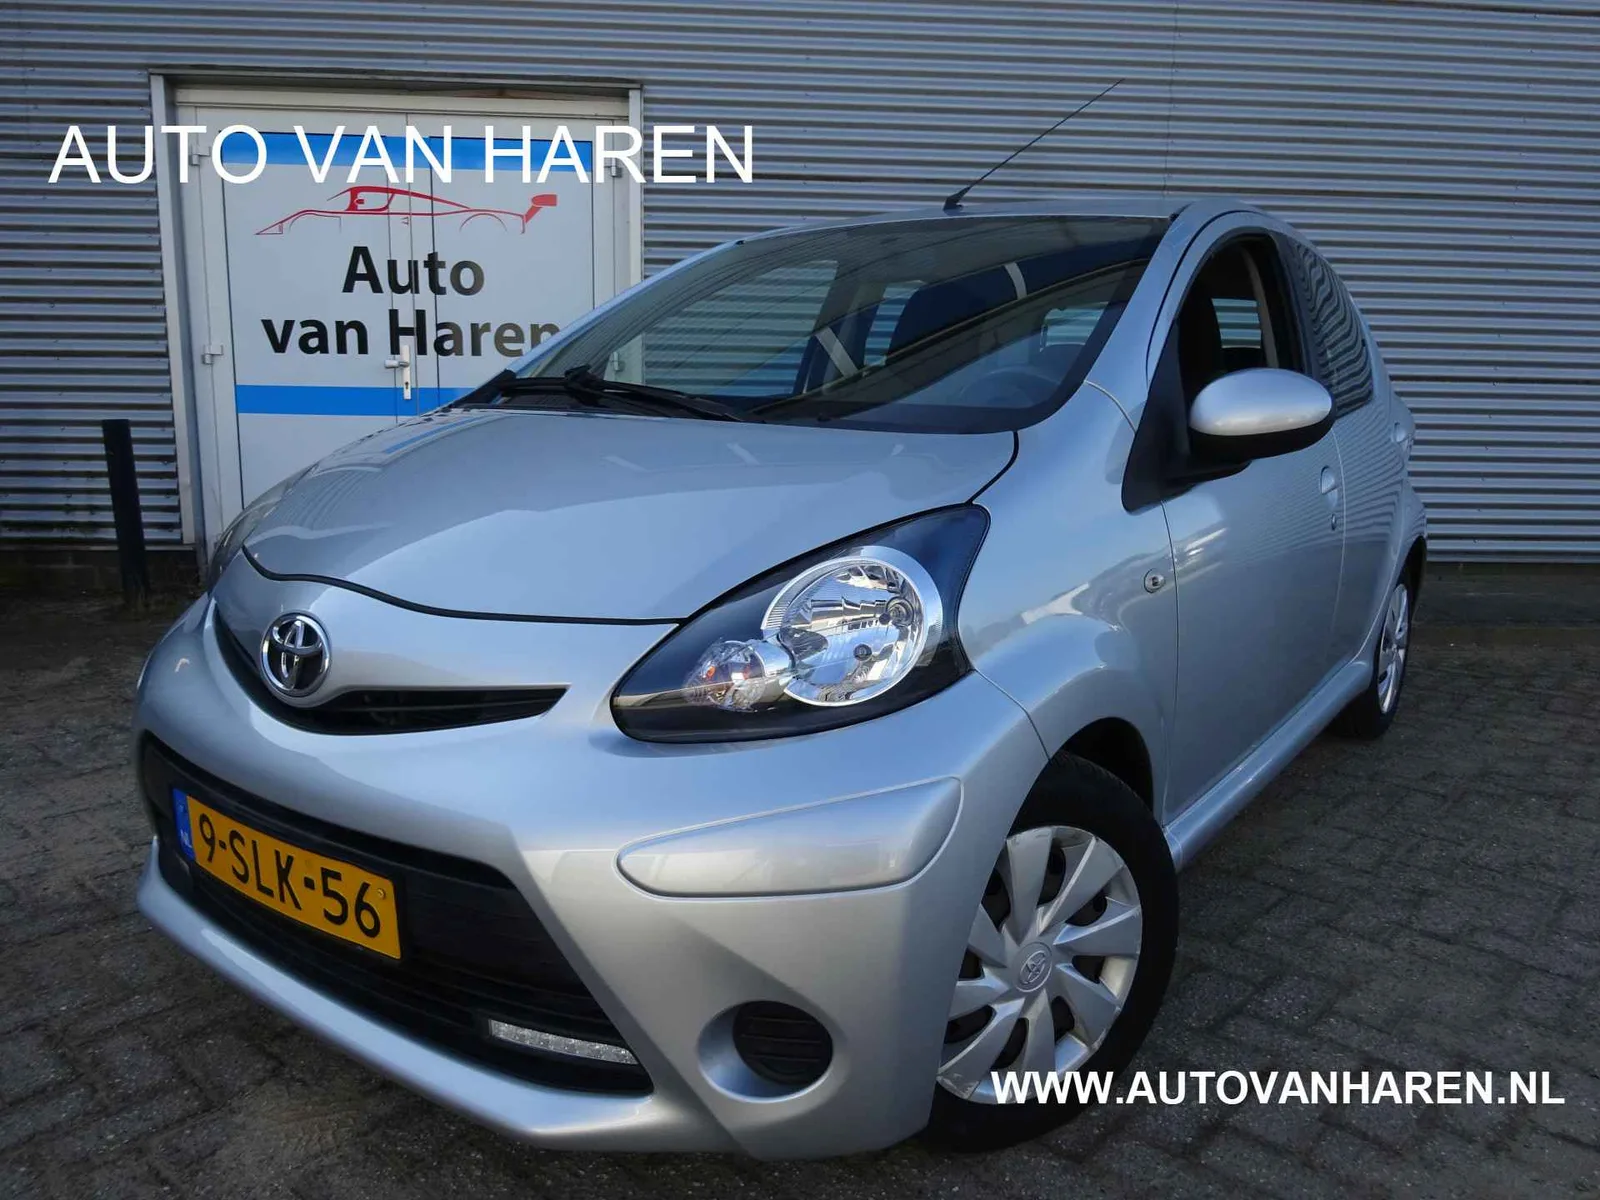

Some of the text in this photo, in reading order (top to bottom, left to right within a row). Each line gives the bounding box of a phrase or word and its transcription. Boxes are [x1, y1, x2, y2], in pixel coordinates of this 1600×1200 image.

[342, 246, 485, 296] Auto
[261, 319, 369, 355] van
[199, 813, 380, 938] 9-SLK-56
